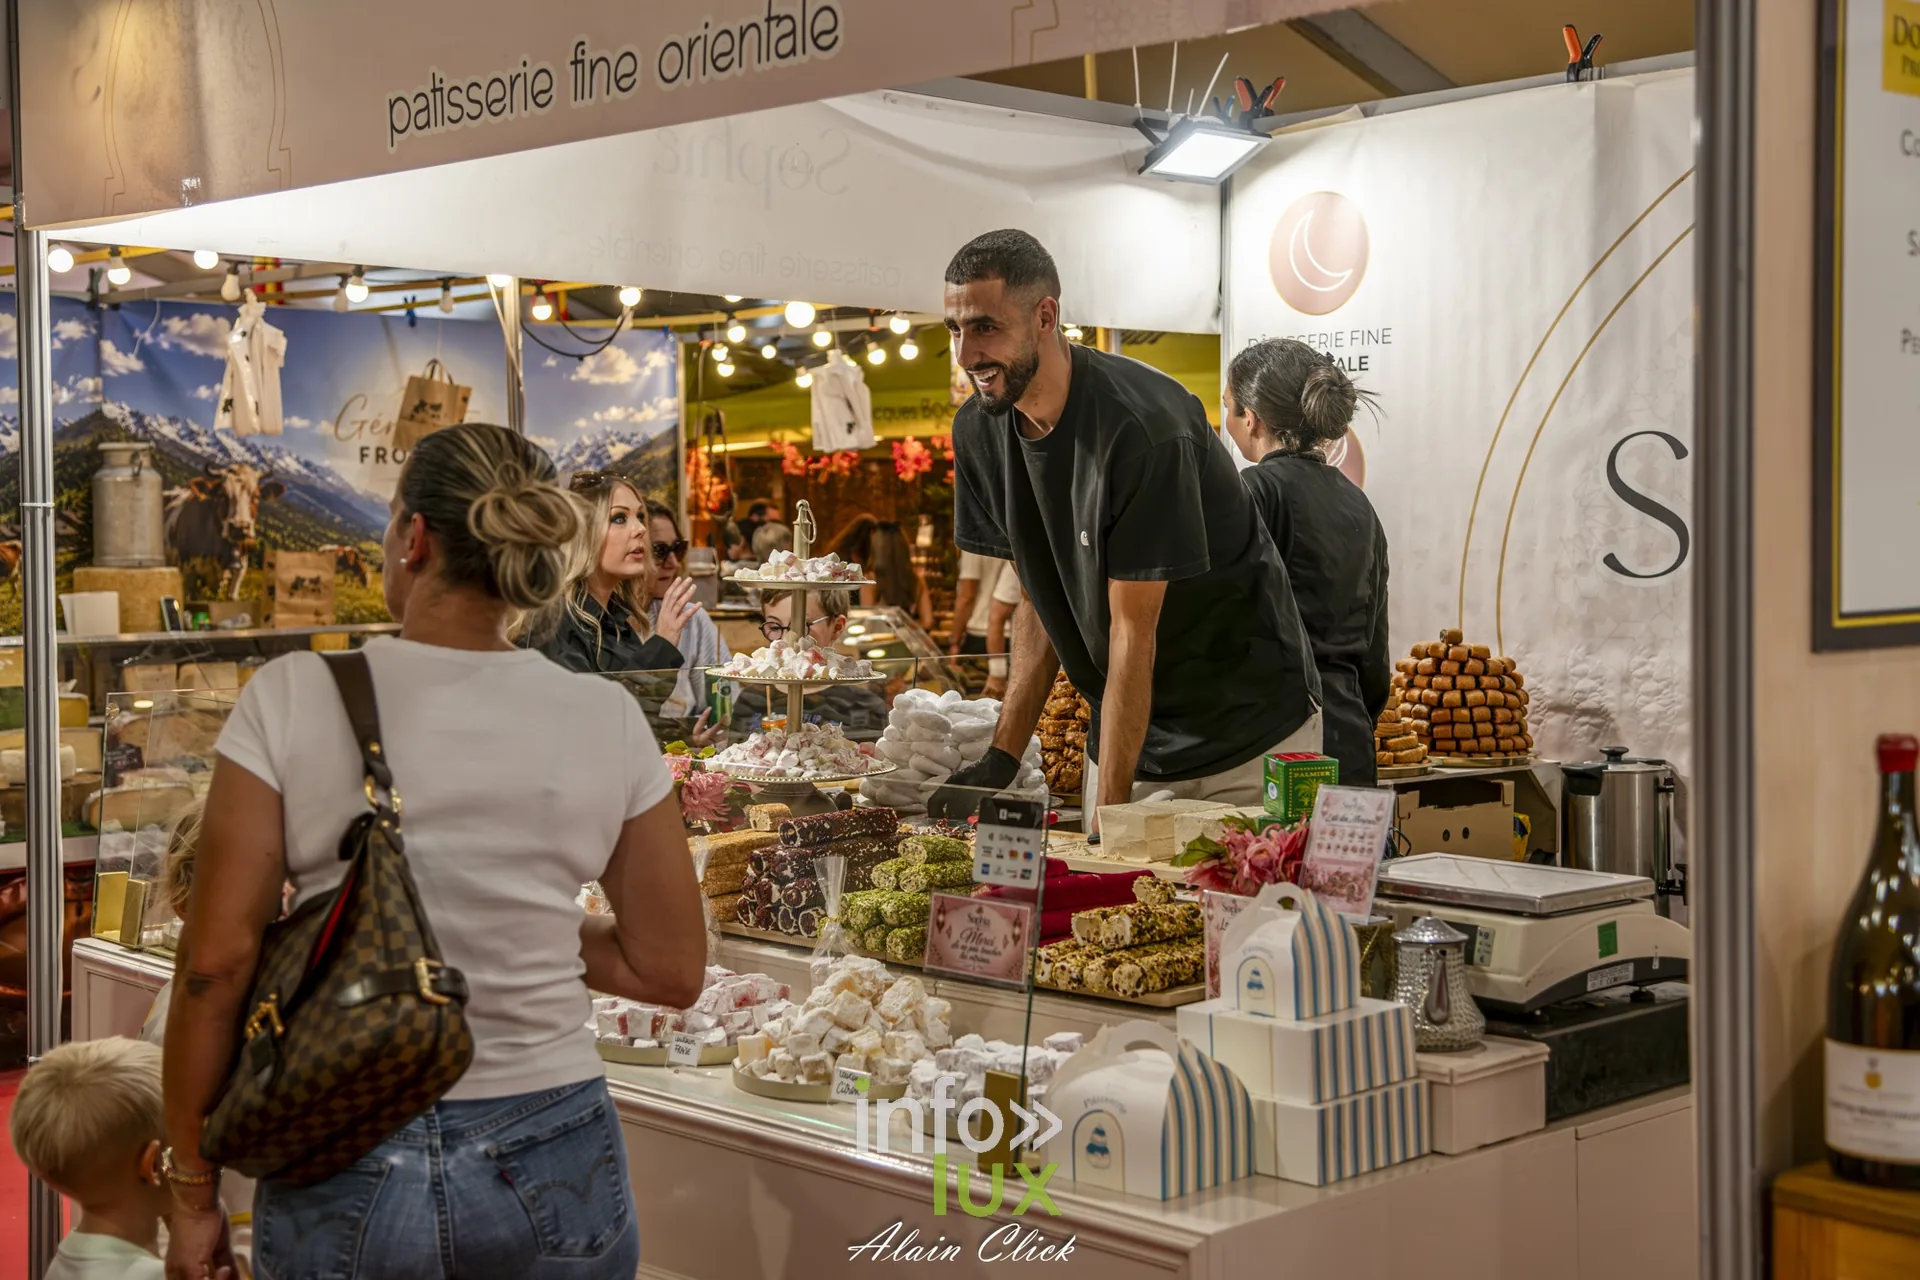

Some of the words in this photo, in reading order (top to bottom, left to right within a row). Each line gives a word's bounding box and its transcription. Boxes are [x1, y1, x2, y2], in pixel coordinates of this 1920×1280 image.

[388, 60, 554, 147] patisserie
[570, 40, 638, 103] fine
[658, 0, 840, 83] orientale
[1350, 327, 1392, 346] FINE
[1603, 430, 1690, 579] S
[1293, 770, 1331, 778] PALMIER
